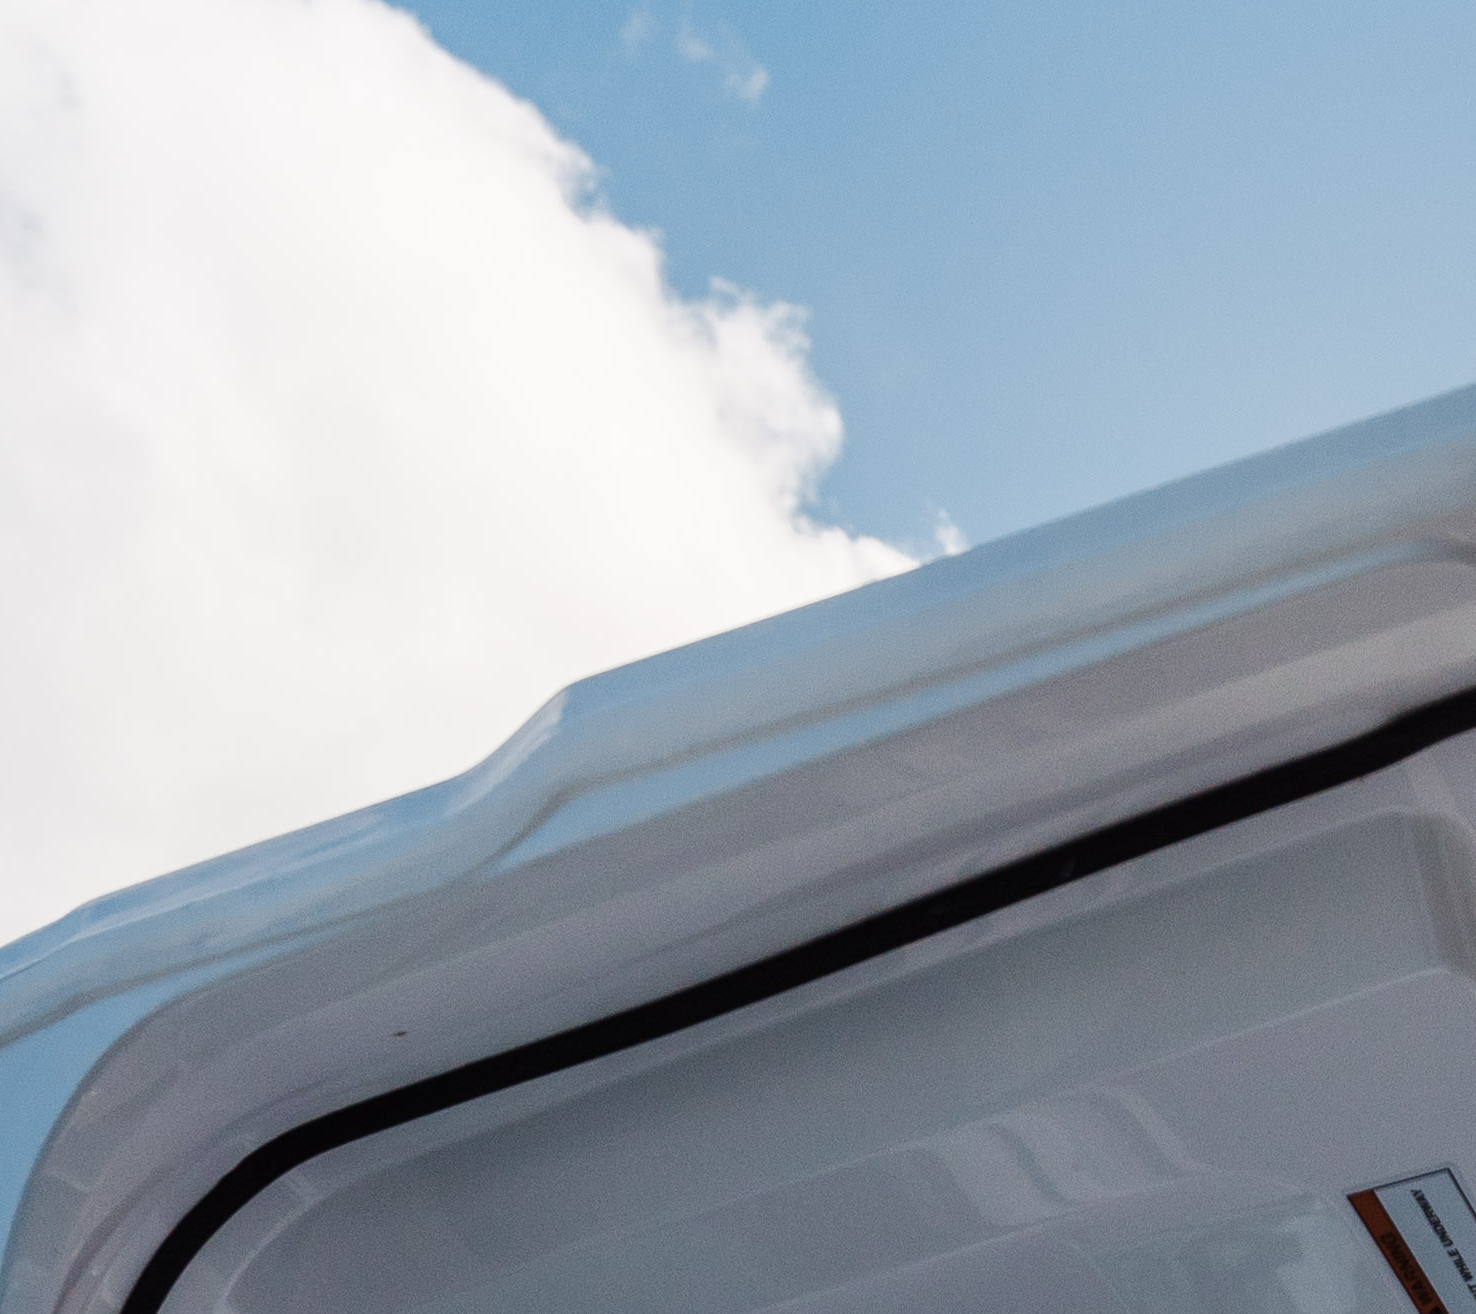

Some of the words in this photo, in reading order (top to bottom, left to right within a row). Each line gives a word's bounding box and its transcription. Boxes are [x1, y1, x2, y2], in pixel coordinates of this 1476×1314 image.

[1410, 1189, 1454, 1247] UNDERWAY
[1379, 1231, 1432, 1305] WARNING
[1447, 1248, 1473, 1282] WHILE
